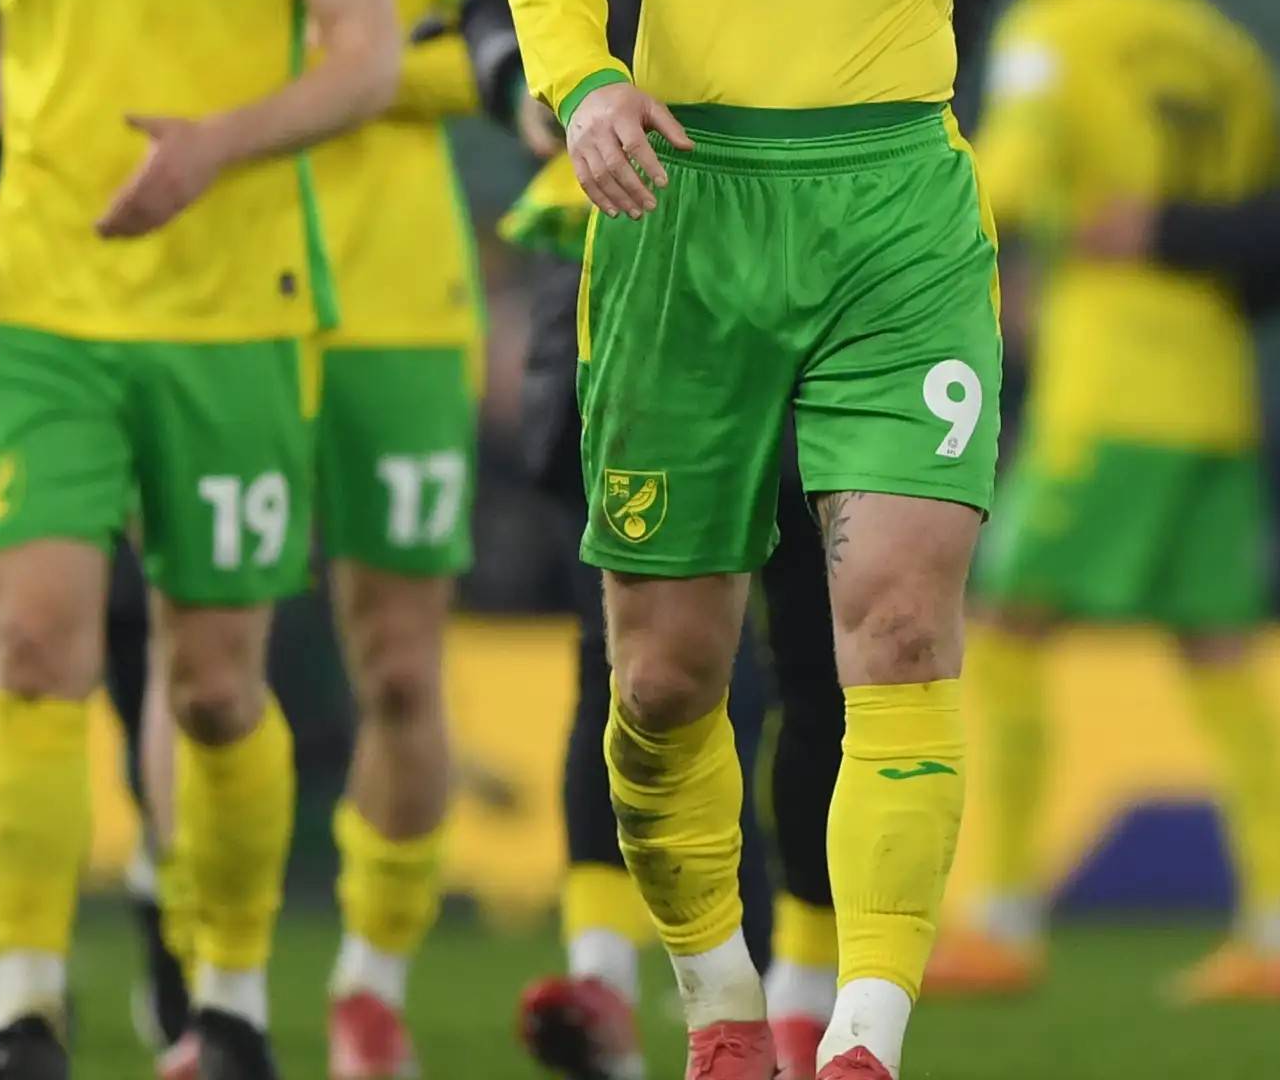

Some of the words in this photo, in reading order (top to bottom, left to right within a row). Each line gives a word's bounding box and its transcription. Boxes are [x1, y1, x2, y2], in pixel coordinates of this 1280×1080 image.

[922, 359, 983, 458] 9
[199, 469, 291, 570] 19
[376, 450, 467, 548] 17
